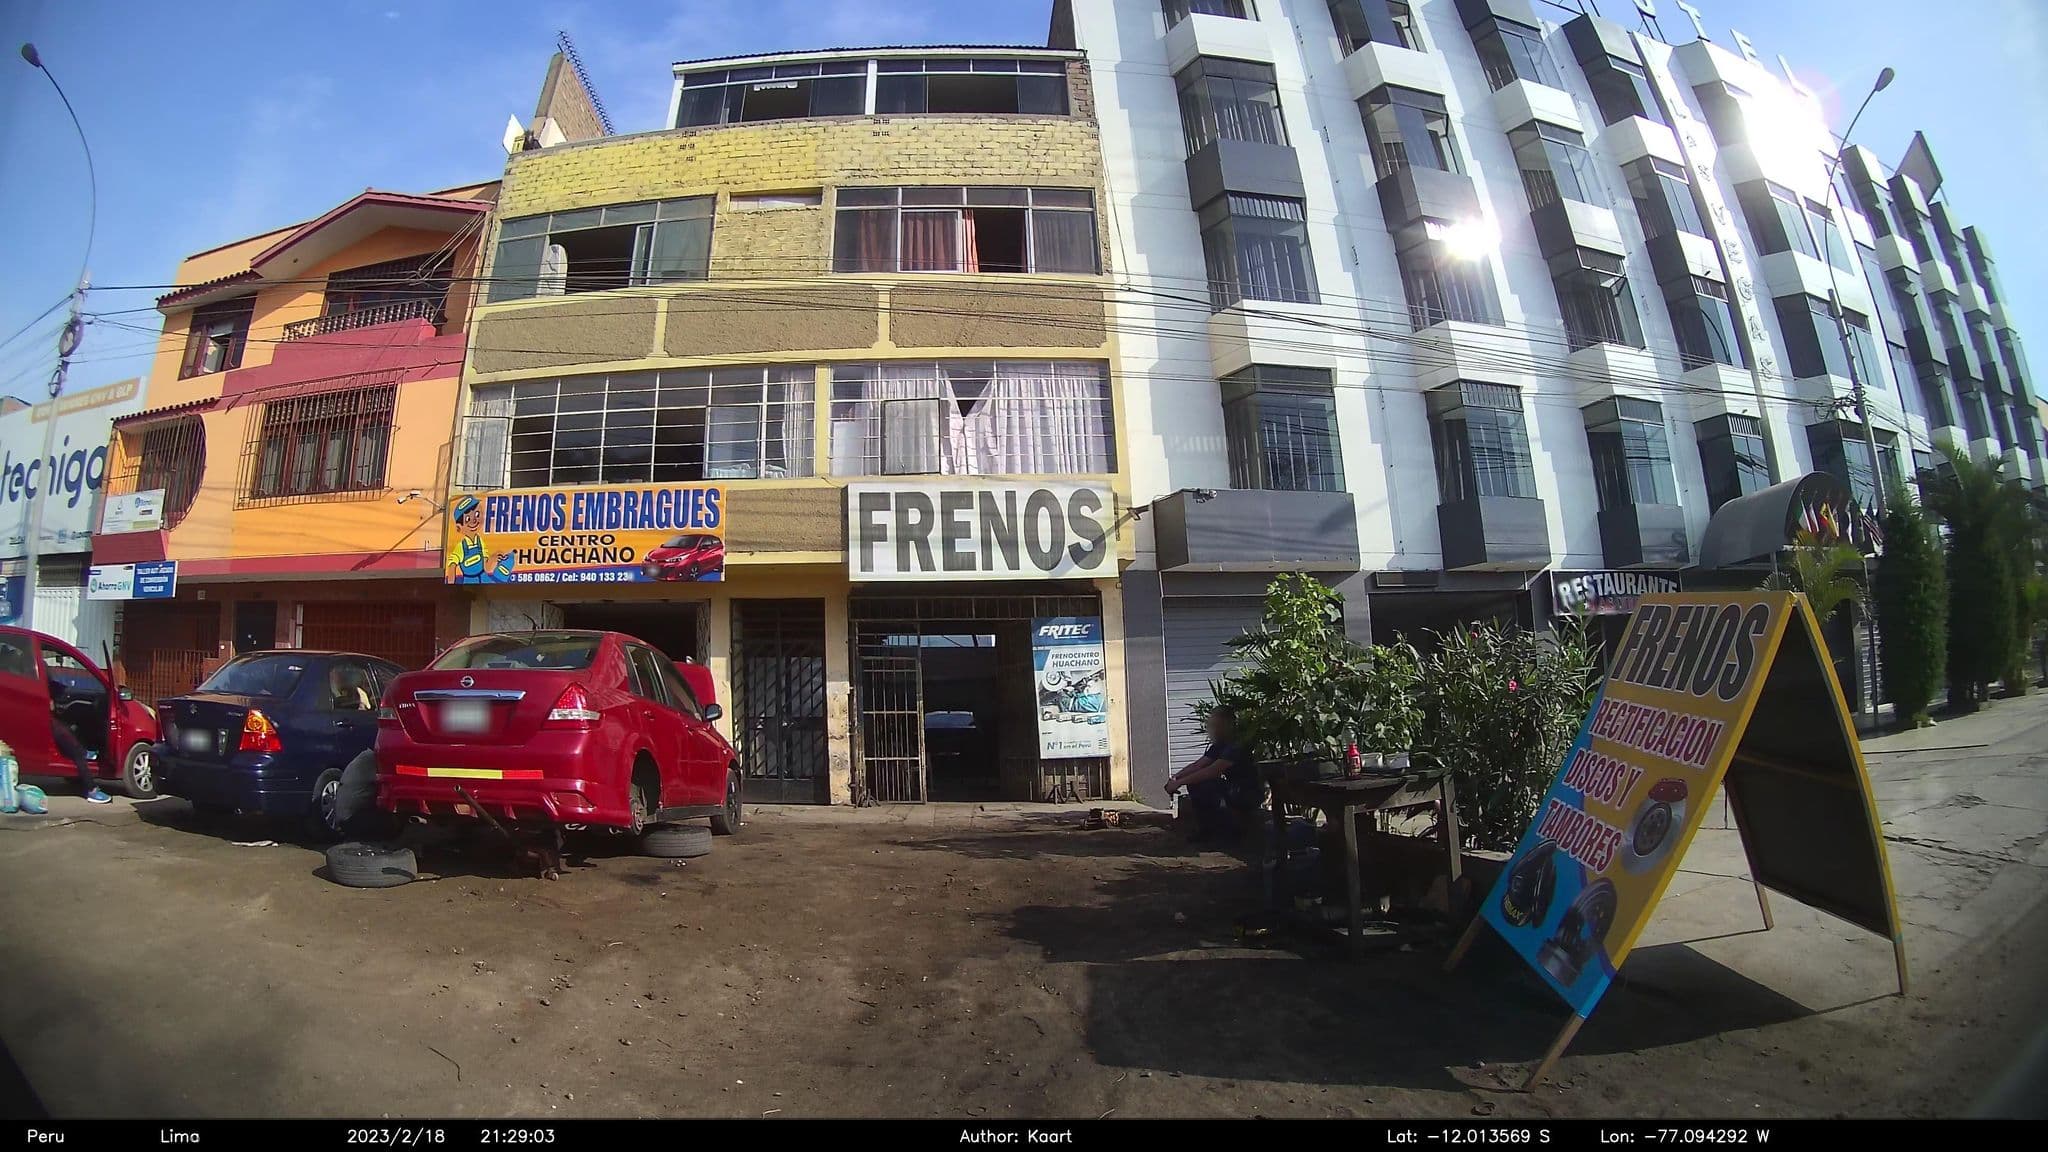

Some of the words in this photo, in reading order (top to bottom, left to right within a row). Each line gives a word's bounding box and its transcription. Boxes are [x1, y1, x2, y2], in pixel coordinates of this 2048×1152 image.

[484, 492, 567, 533] FRENOS
[571, 487, 722, 531] EMBRAGUES
[538, 534, 616, 547] CENTRO
[858, 488, 1107, 572] FRENOS
[518, 546, 635, 565] HUACHANO
[517, 573, 533, 582] 586
[562, 572, 579, 582] Cel:
[580, 572, 597, 582] 940
[599, 572, 615, 581] 133
[1557, 572, 1678, 605] RESTAURANTE
[1038, 623, 1092, 640] FRITEC
[1051, 651, 1100, 660] FRENOCENTRO
[1052, 658, 1100, 668] HUACHANO
[1610, 603, 1769, 701] FRENOS
[1588, 697, 1725, 769] RECTIFICACION
[1562, 750, 1626, 803] DISCOS
[1616, 767, 1642, 809] Y
[1536, 799, 1623, 873] TAMBORES
